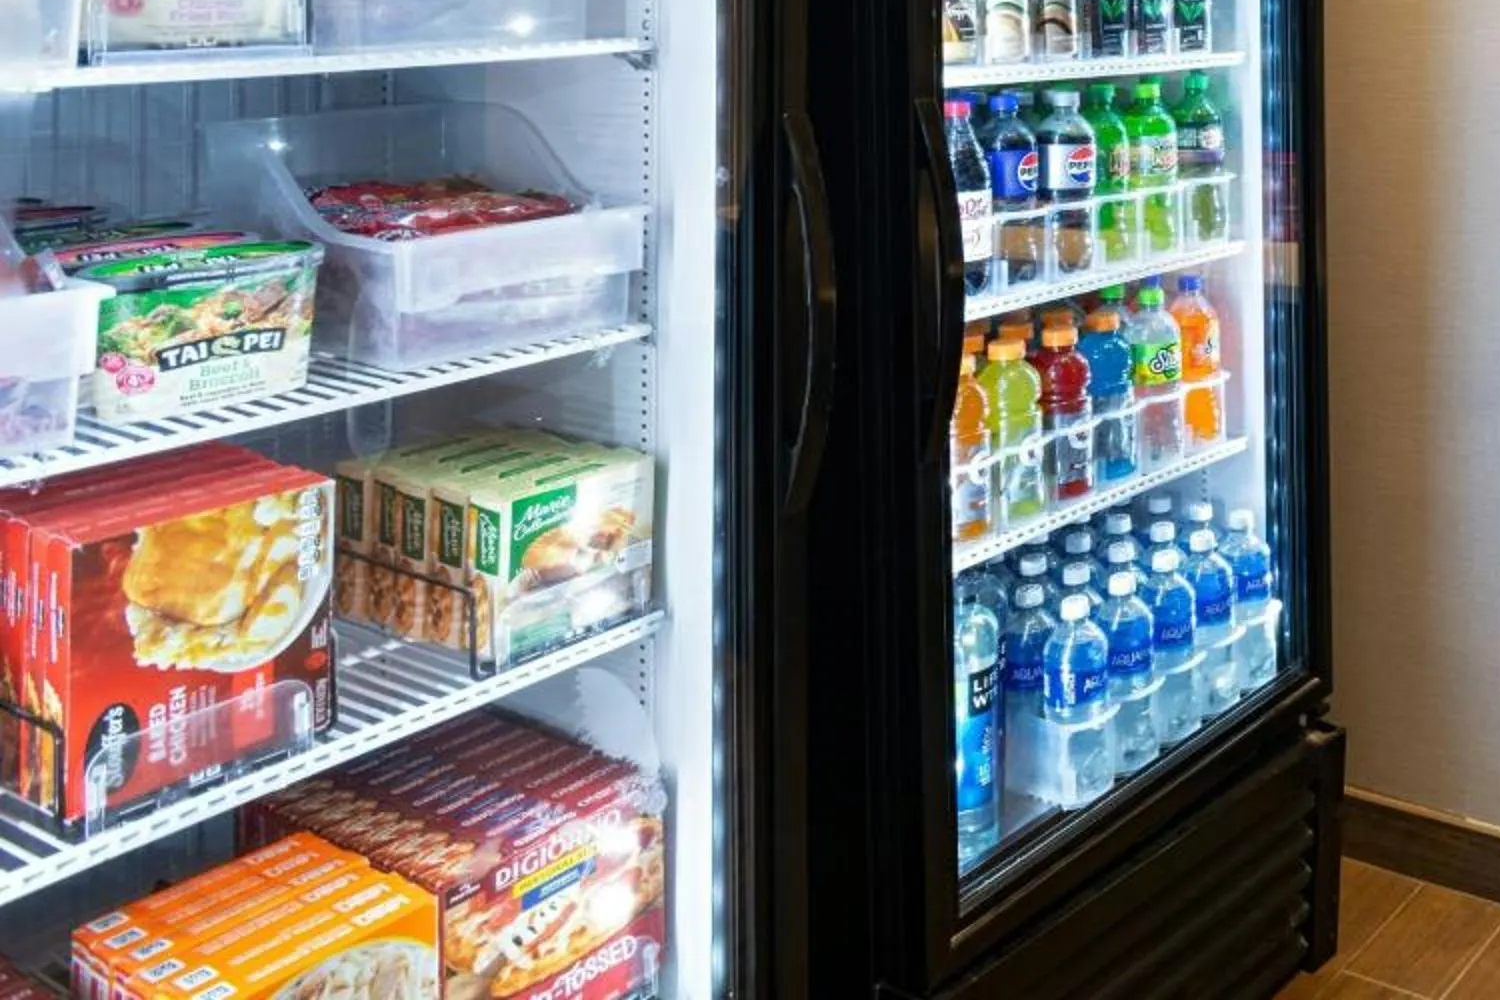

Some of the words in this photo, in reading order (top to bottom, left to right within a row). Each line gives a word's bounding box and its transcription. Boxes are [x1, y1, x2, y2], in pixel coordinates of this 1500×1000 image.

[163, 341, 209, 368] TAI
[243, 331, 282, 351] PEI
[168, 684, 188, 766] CHICKEN
